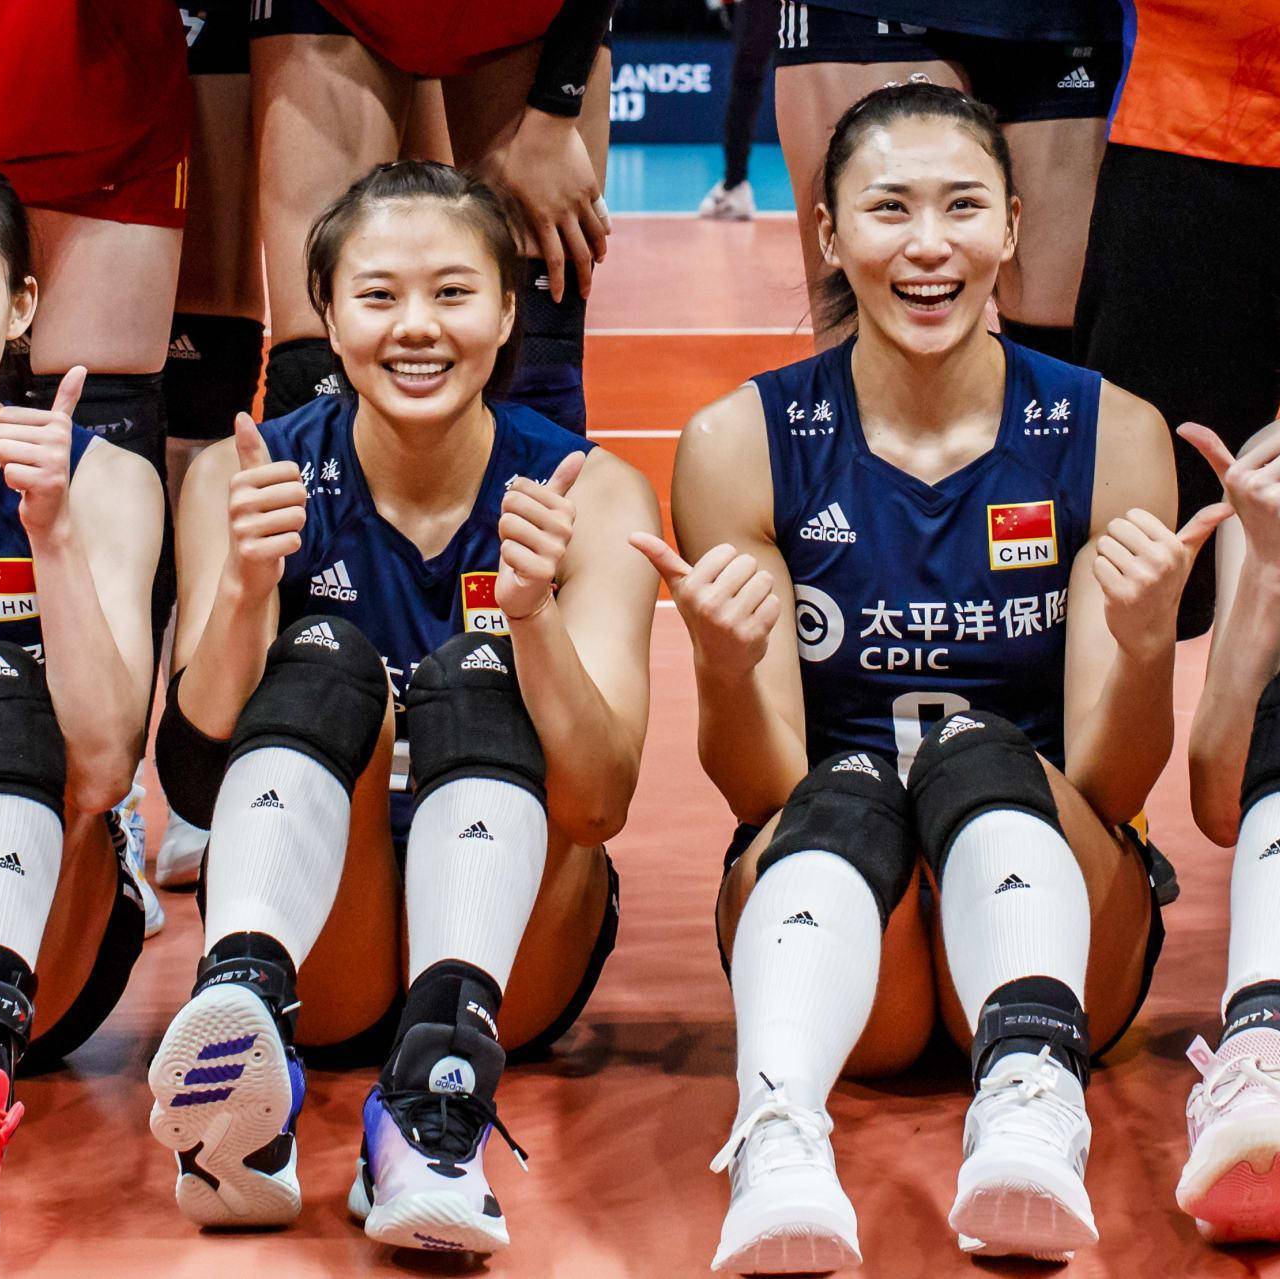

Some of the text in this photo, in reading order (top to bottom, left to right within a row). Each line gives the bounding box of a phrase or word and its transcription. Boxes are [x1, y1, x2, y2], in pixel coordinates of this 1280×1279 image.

[1057, 78, 1095, 89] adidas
[786, 399, 834, 423] 红旗
[1023, 398, 1072, 423] 红旗
[799, 524, 857, 544] adidas
[999, 543, 1050, 563] CHN
[474, 614, 506, 630] CH
[859, 592, 1068, 643] 太平洋保险
[293, 634, 341, 651] adidas
[460, 658, 508, 675] adidas
[859, 646, 951, 671] CPIC
[938, 719, 986, 745] adidas
[831, 761, 881, 782] adidas
[250, 800, 285, 810] adidas
[458, 831, 494, 842] adidas
[994, 882, 1031, 895] adidas
[782, 917, 819, 928] adidas
[434, 1080, 467, 1092] adidas
